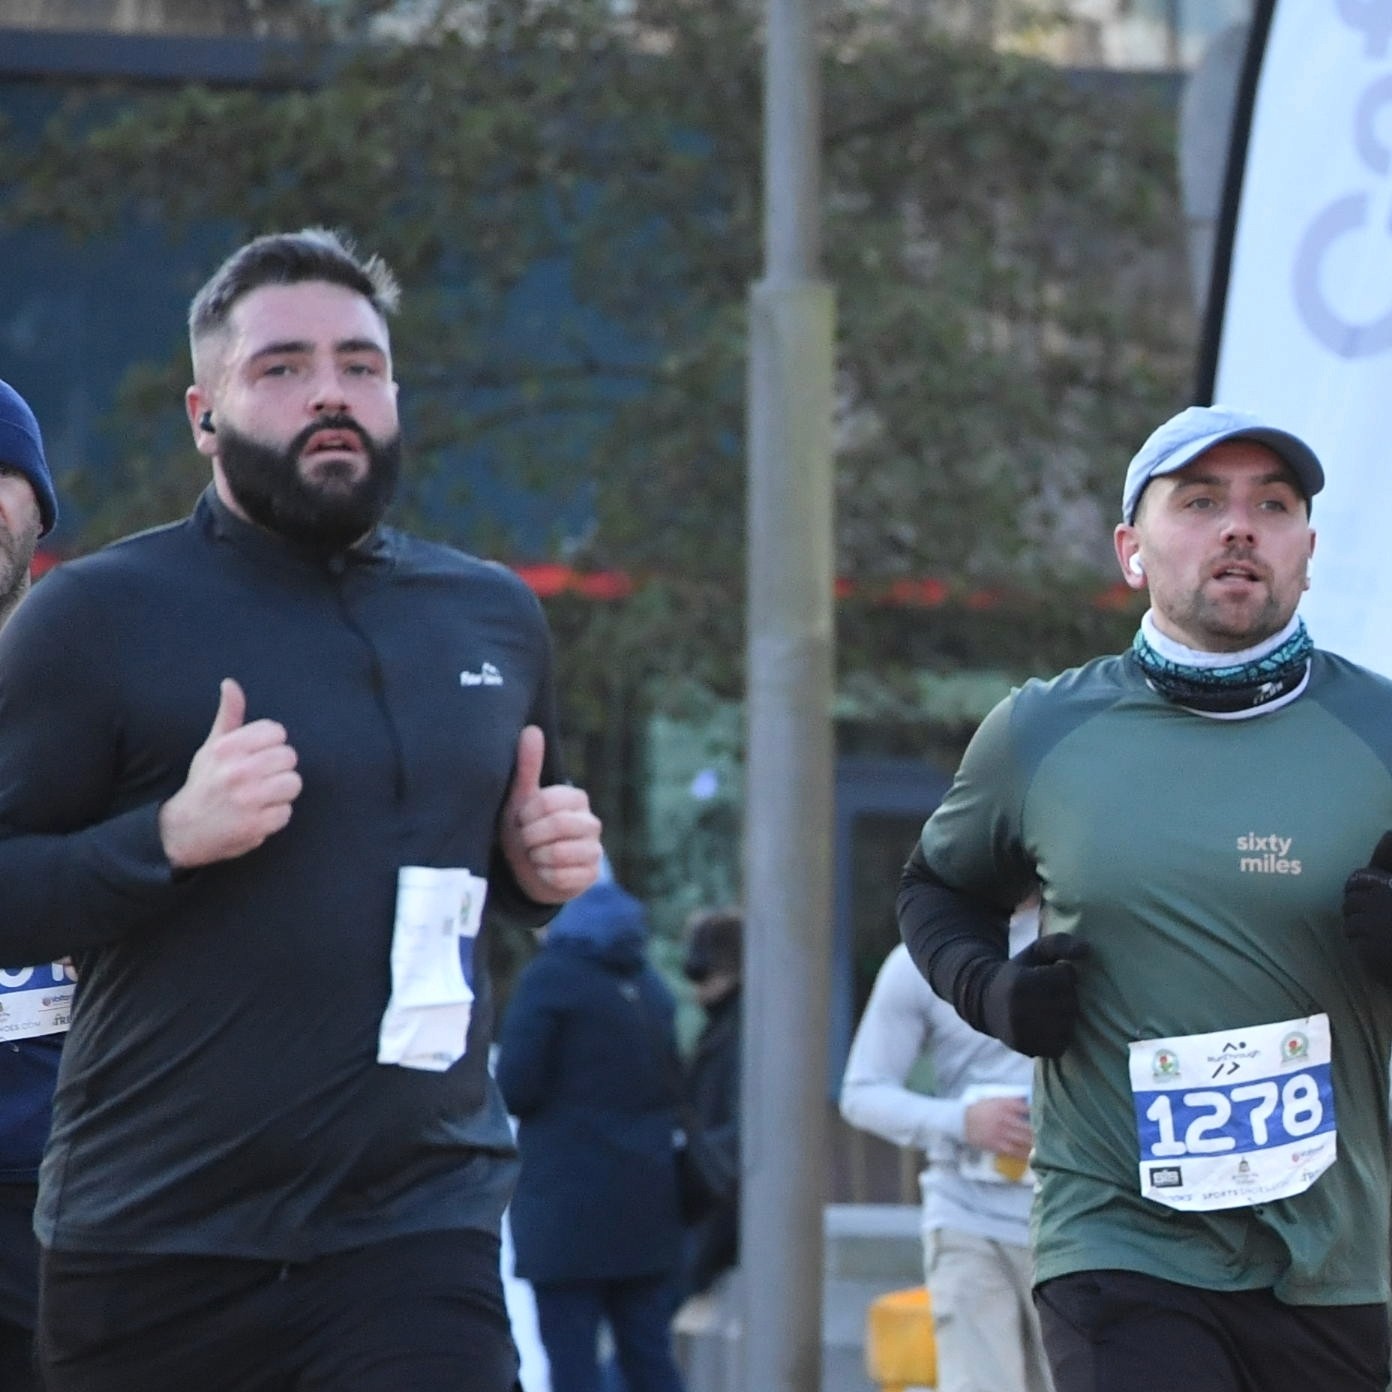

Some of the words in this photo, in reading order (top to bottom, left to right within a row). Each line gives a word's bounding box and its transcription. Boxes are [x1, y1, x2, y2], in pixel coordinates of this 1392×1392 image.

[1236, 831, 1292, 857] sixty
[1240, 853, 1302, 875] miles
[1146, 1073, 1323, 1156] 1278
